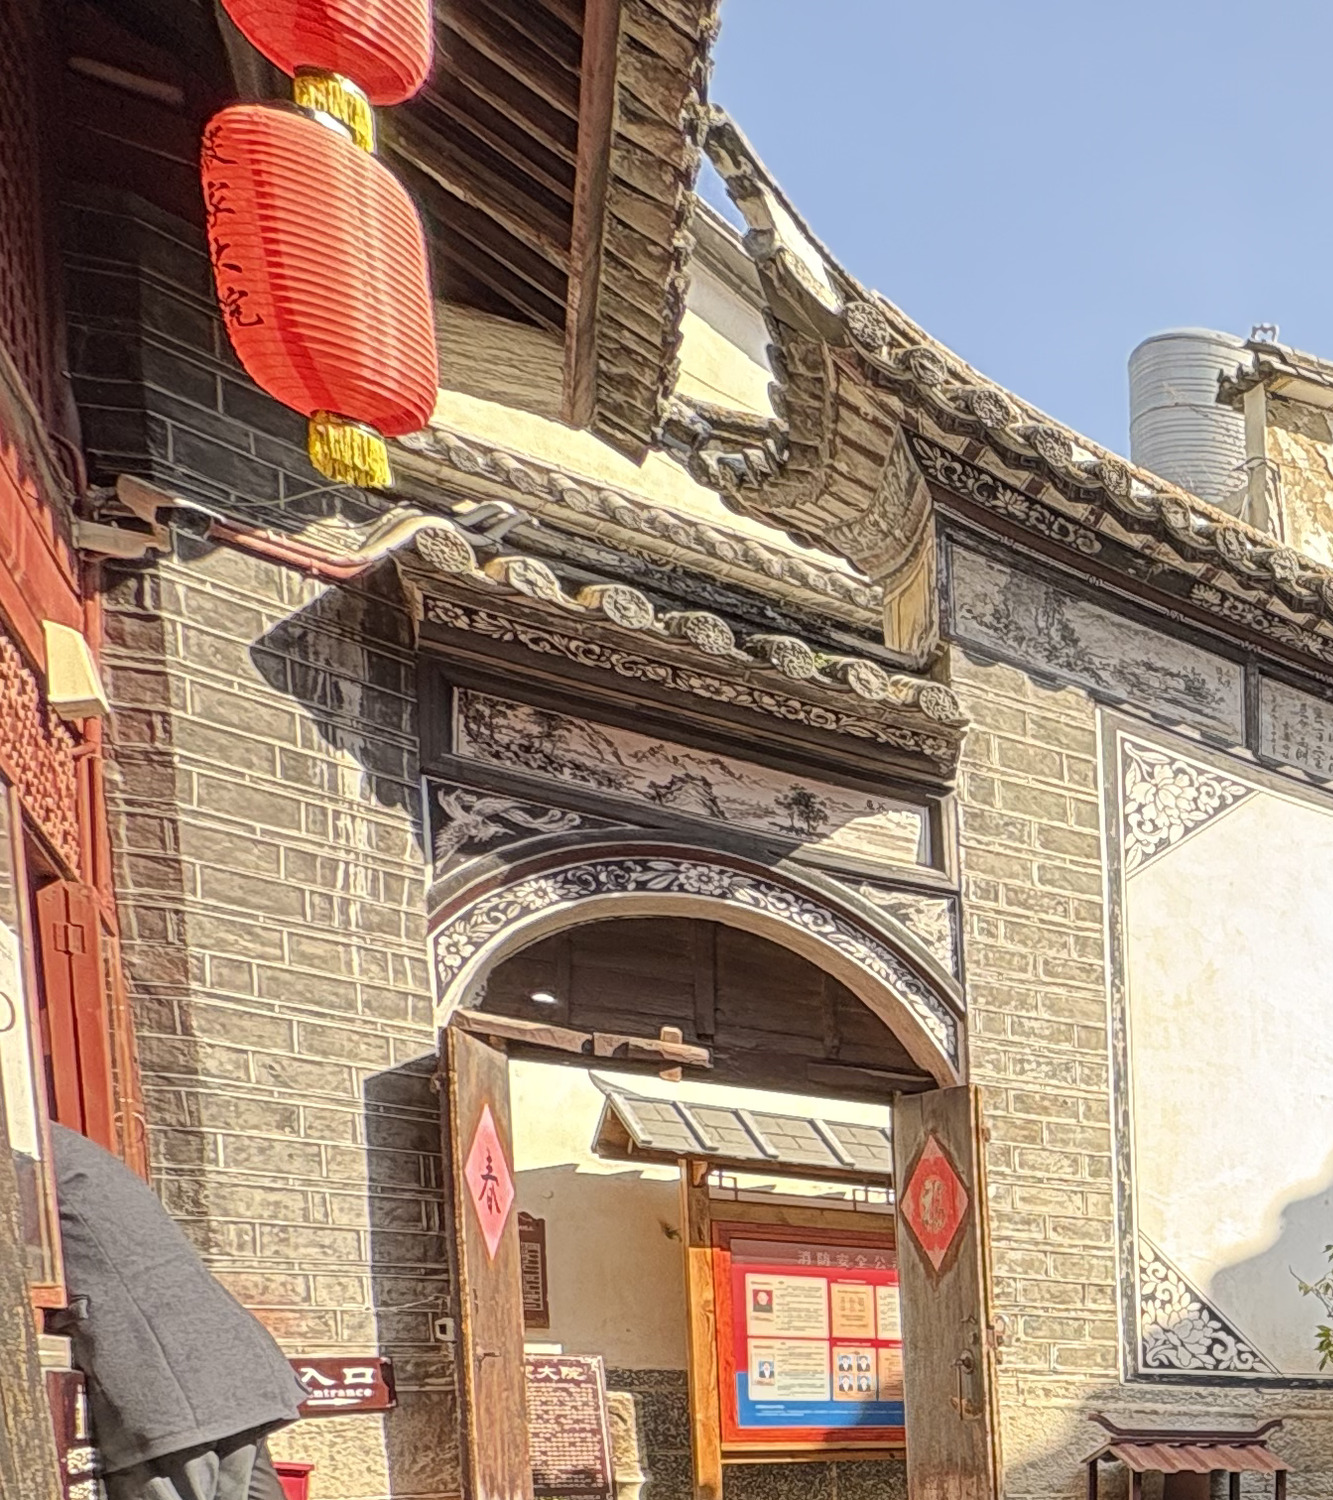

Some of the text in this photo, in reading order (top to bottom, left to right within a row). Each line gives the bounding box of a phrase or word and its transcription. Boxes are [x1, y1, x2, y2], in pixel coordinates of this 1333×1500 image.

[798, 1250, 899, 1269] 消防安全公
[300, 1367, 375, 1386] 入口
